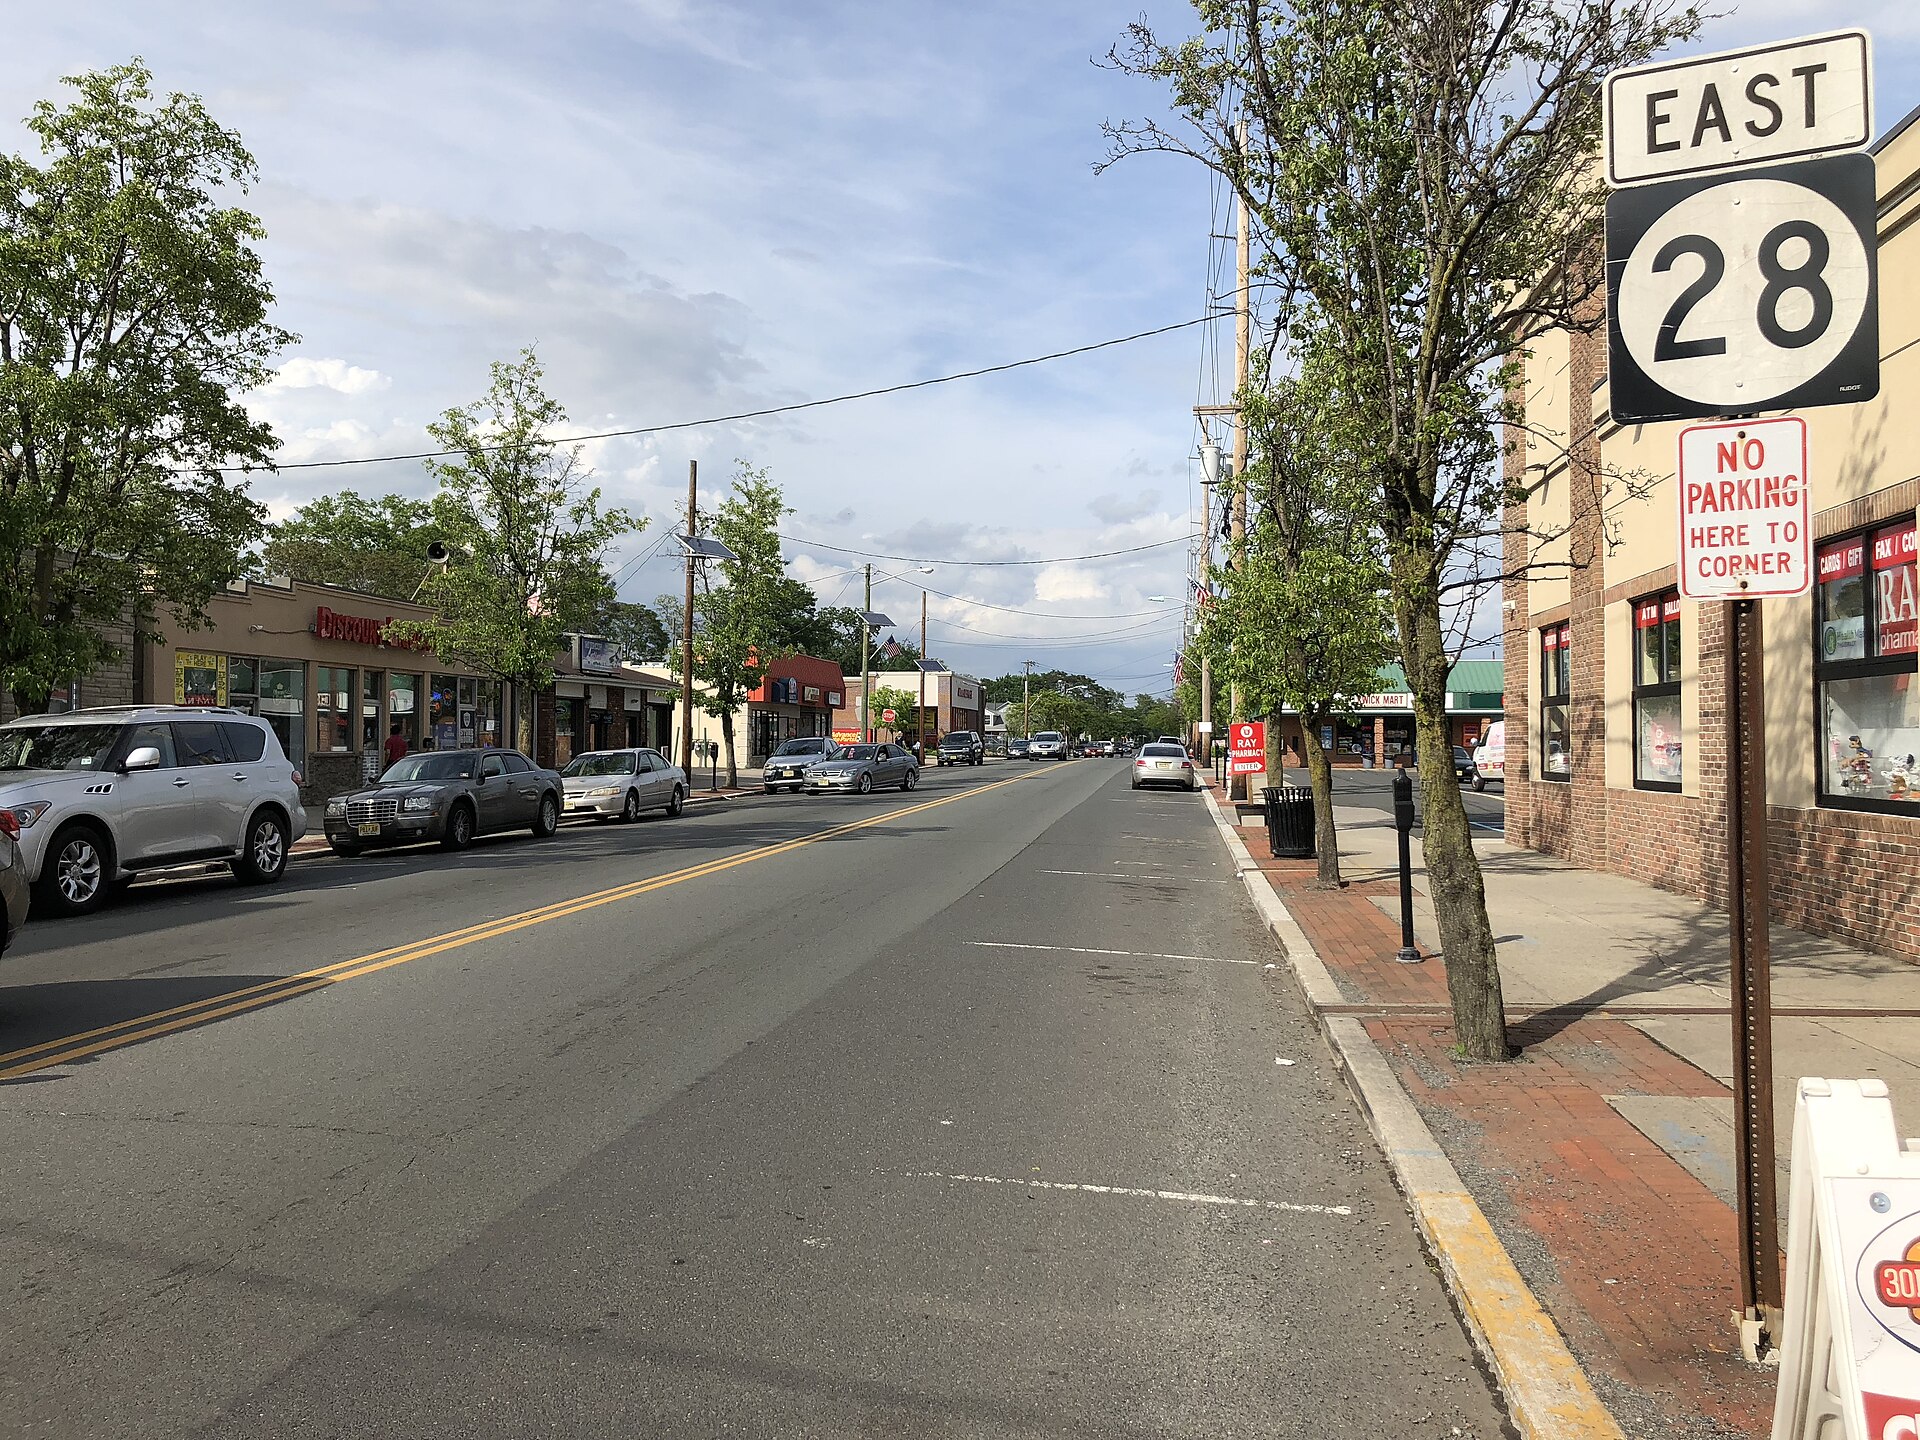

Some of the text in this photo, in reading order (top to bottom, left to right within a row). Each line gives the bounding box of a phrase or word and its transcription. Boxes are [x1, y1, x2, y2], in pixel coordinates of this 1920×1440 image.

[1646, 62, 1827, 154] EAST
[1651, 220, 1833, 362] 28
[1717, 438, 1765, 474] NO
[1687, 474, 1798, 514] PARKING
[1690, 522, 1798, 549] HERE TO
[1875, 537, 1892, 560] FAX
[1698, 552, 1791, 577] CORNER
[1820, 554, 1841, 575] CARDS
[1641, 605, 1657, 621] ATM
[1382, 694, 1404, 705] MART
[1231, 749, 1264, 758] PHARMACY
[1237, 738, 1257, 748] RAY
